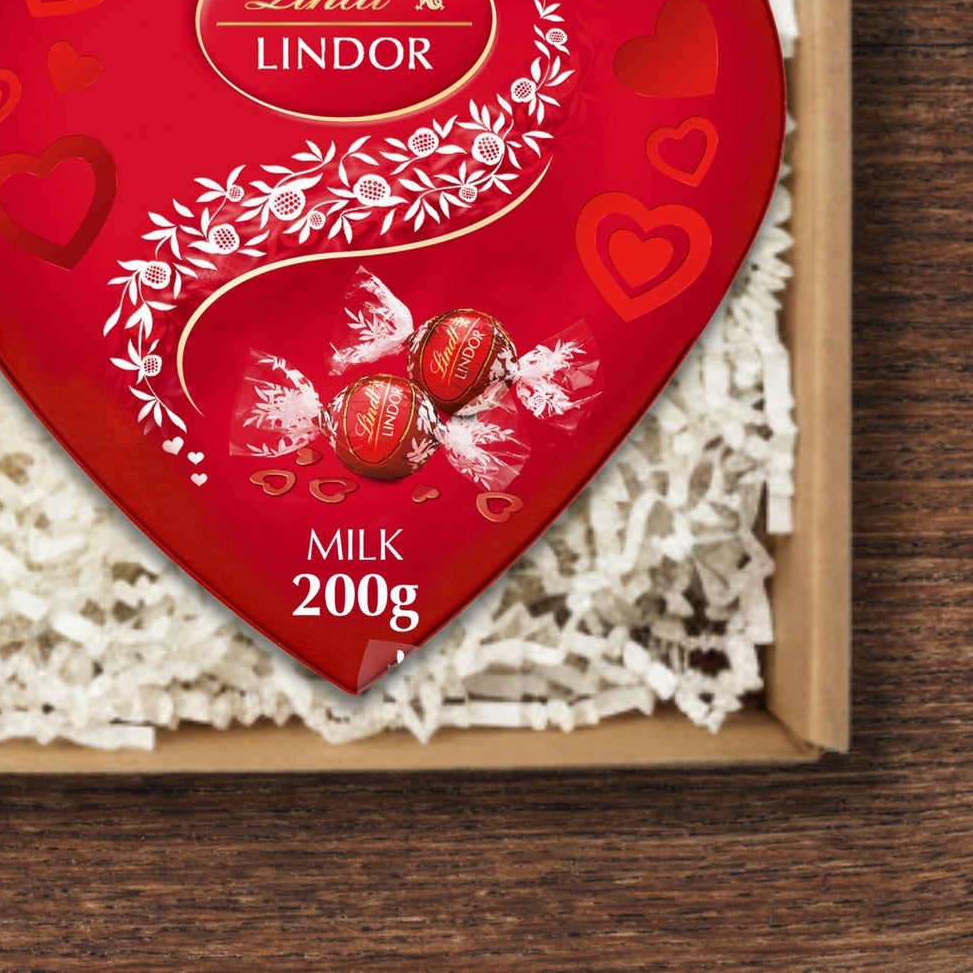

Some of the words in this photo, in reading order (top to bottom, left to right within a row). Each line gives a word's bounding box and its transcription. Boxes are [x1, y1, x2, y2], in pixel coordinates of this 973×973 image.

[257, 36, 433, 71] LINDOR
[454, 329, 486, 380] LINDOR
[381, 387, 404, 438] LINDOR
[307, 528, 404, 561] MILK
[292, 573, 420, 633] 200g
